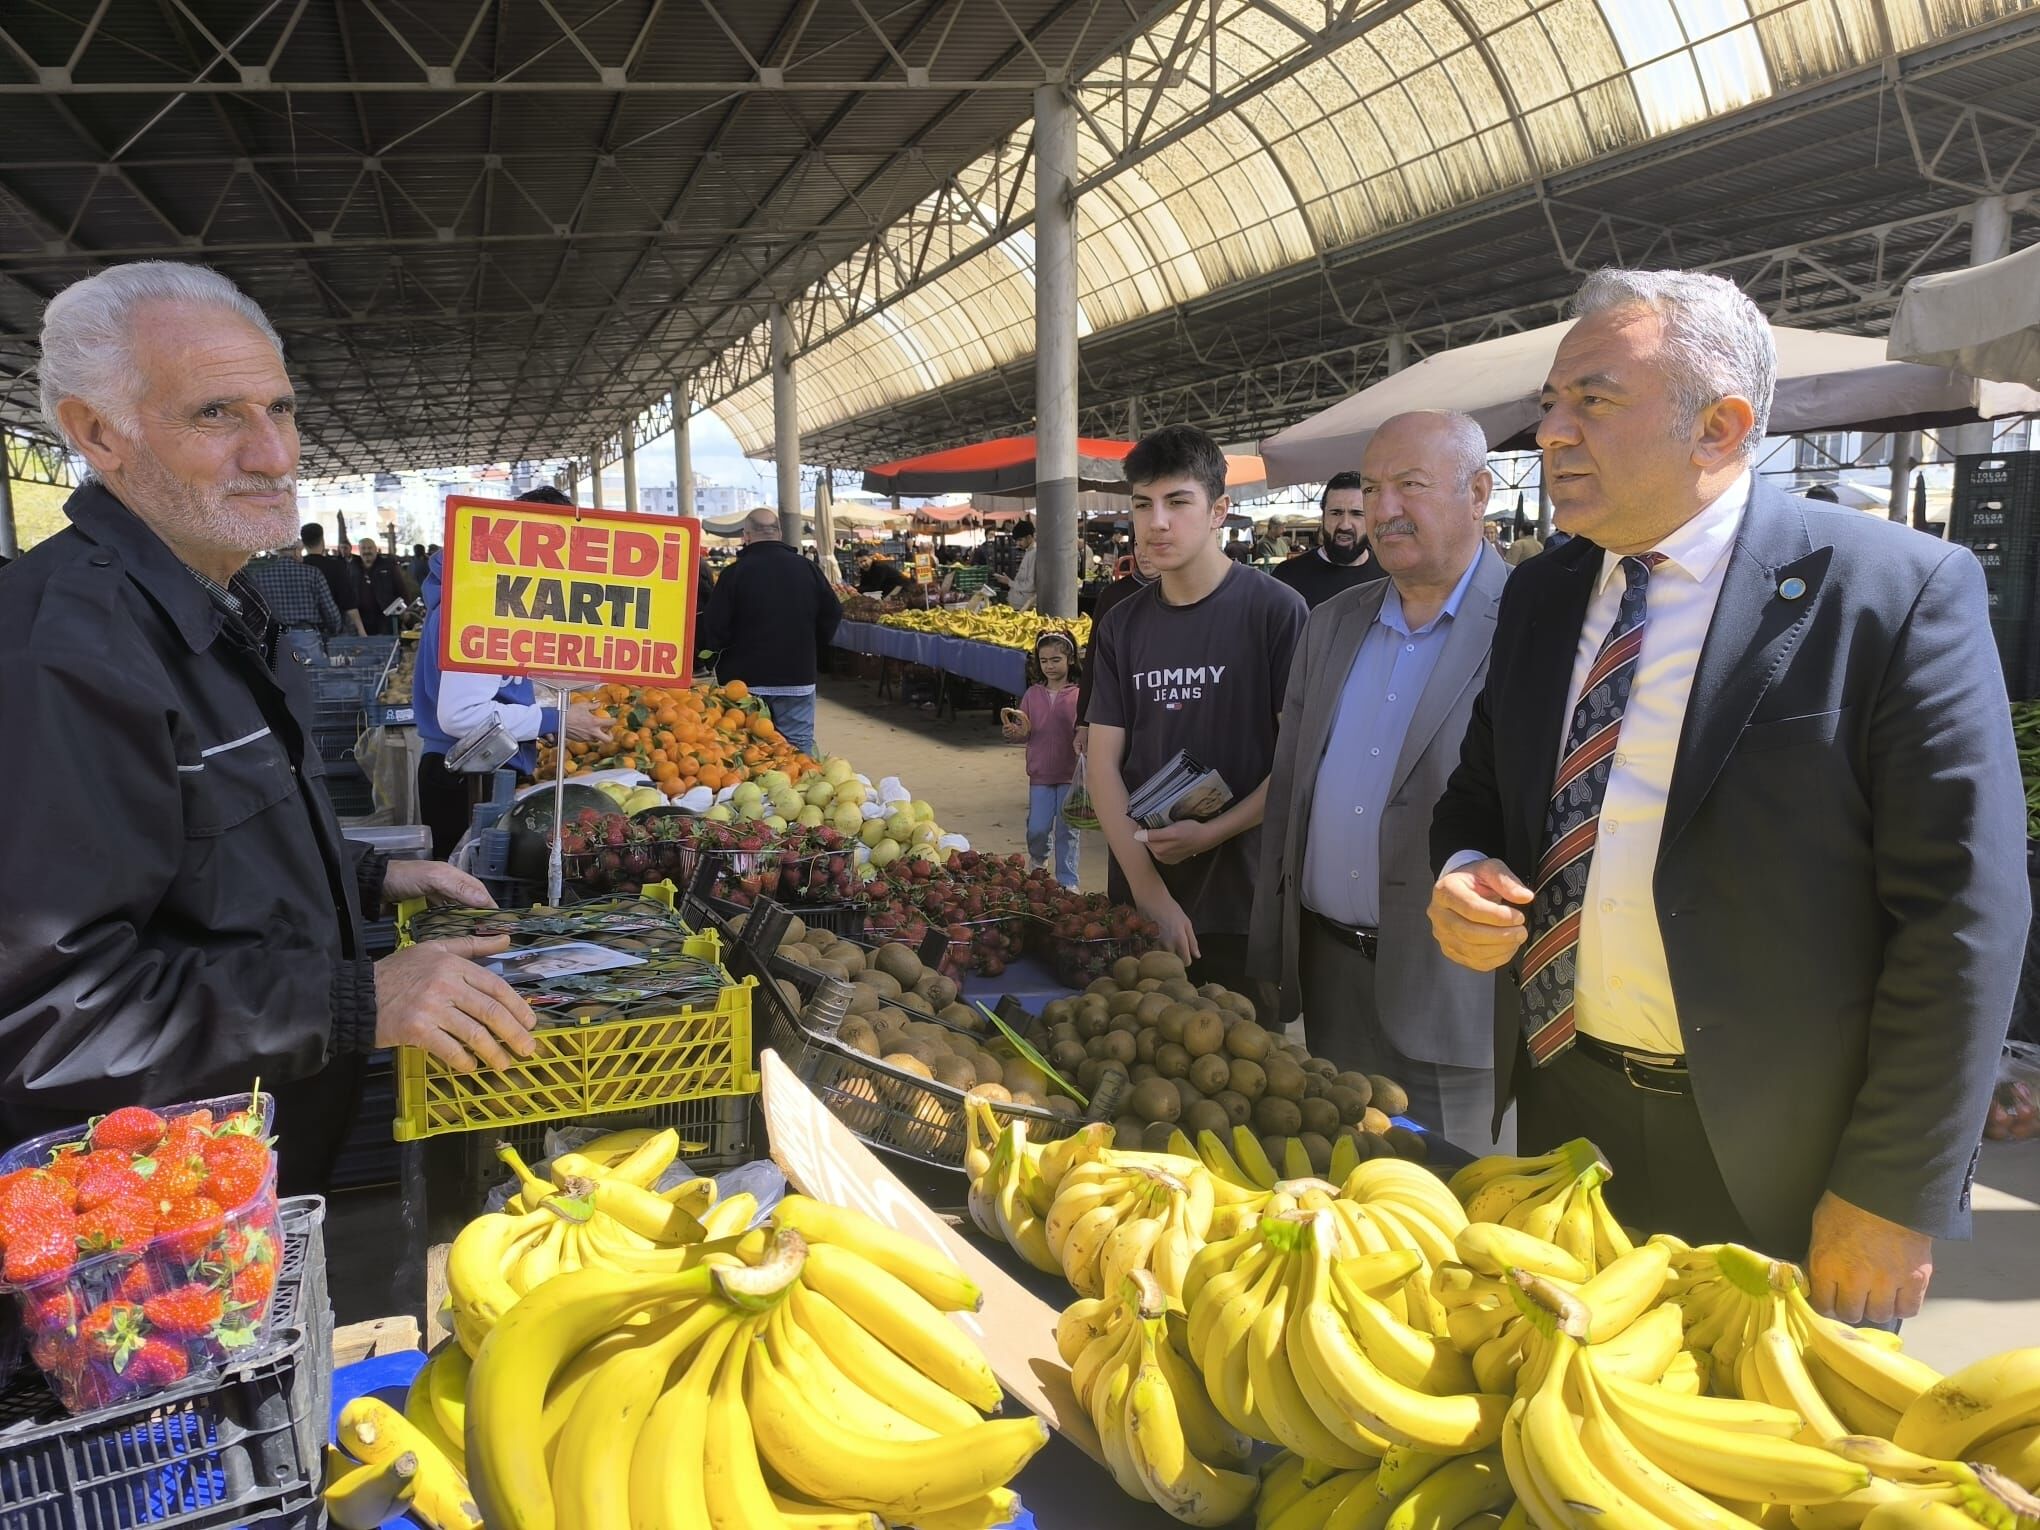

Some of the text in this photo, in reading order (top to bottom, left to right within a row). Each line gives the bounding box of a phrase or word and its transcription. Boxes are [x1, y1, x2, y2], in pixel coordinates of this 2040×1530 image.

[470, 516, 681, 581] KREDİ
[495, 574, 651, 629] KARTI
[460, 625, 678, 675] GEÇERLİDİR
[1132, 666, 1226, 690] TOMMY
[1153, 687, 1202, 702] JEANS
